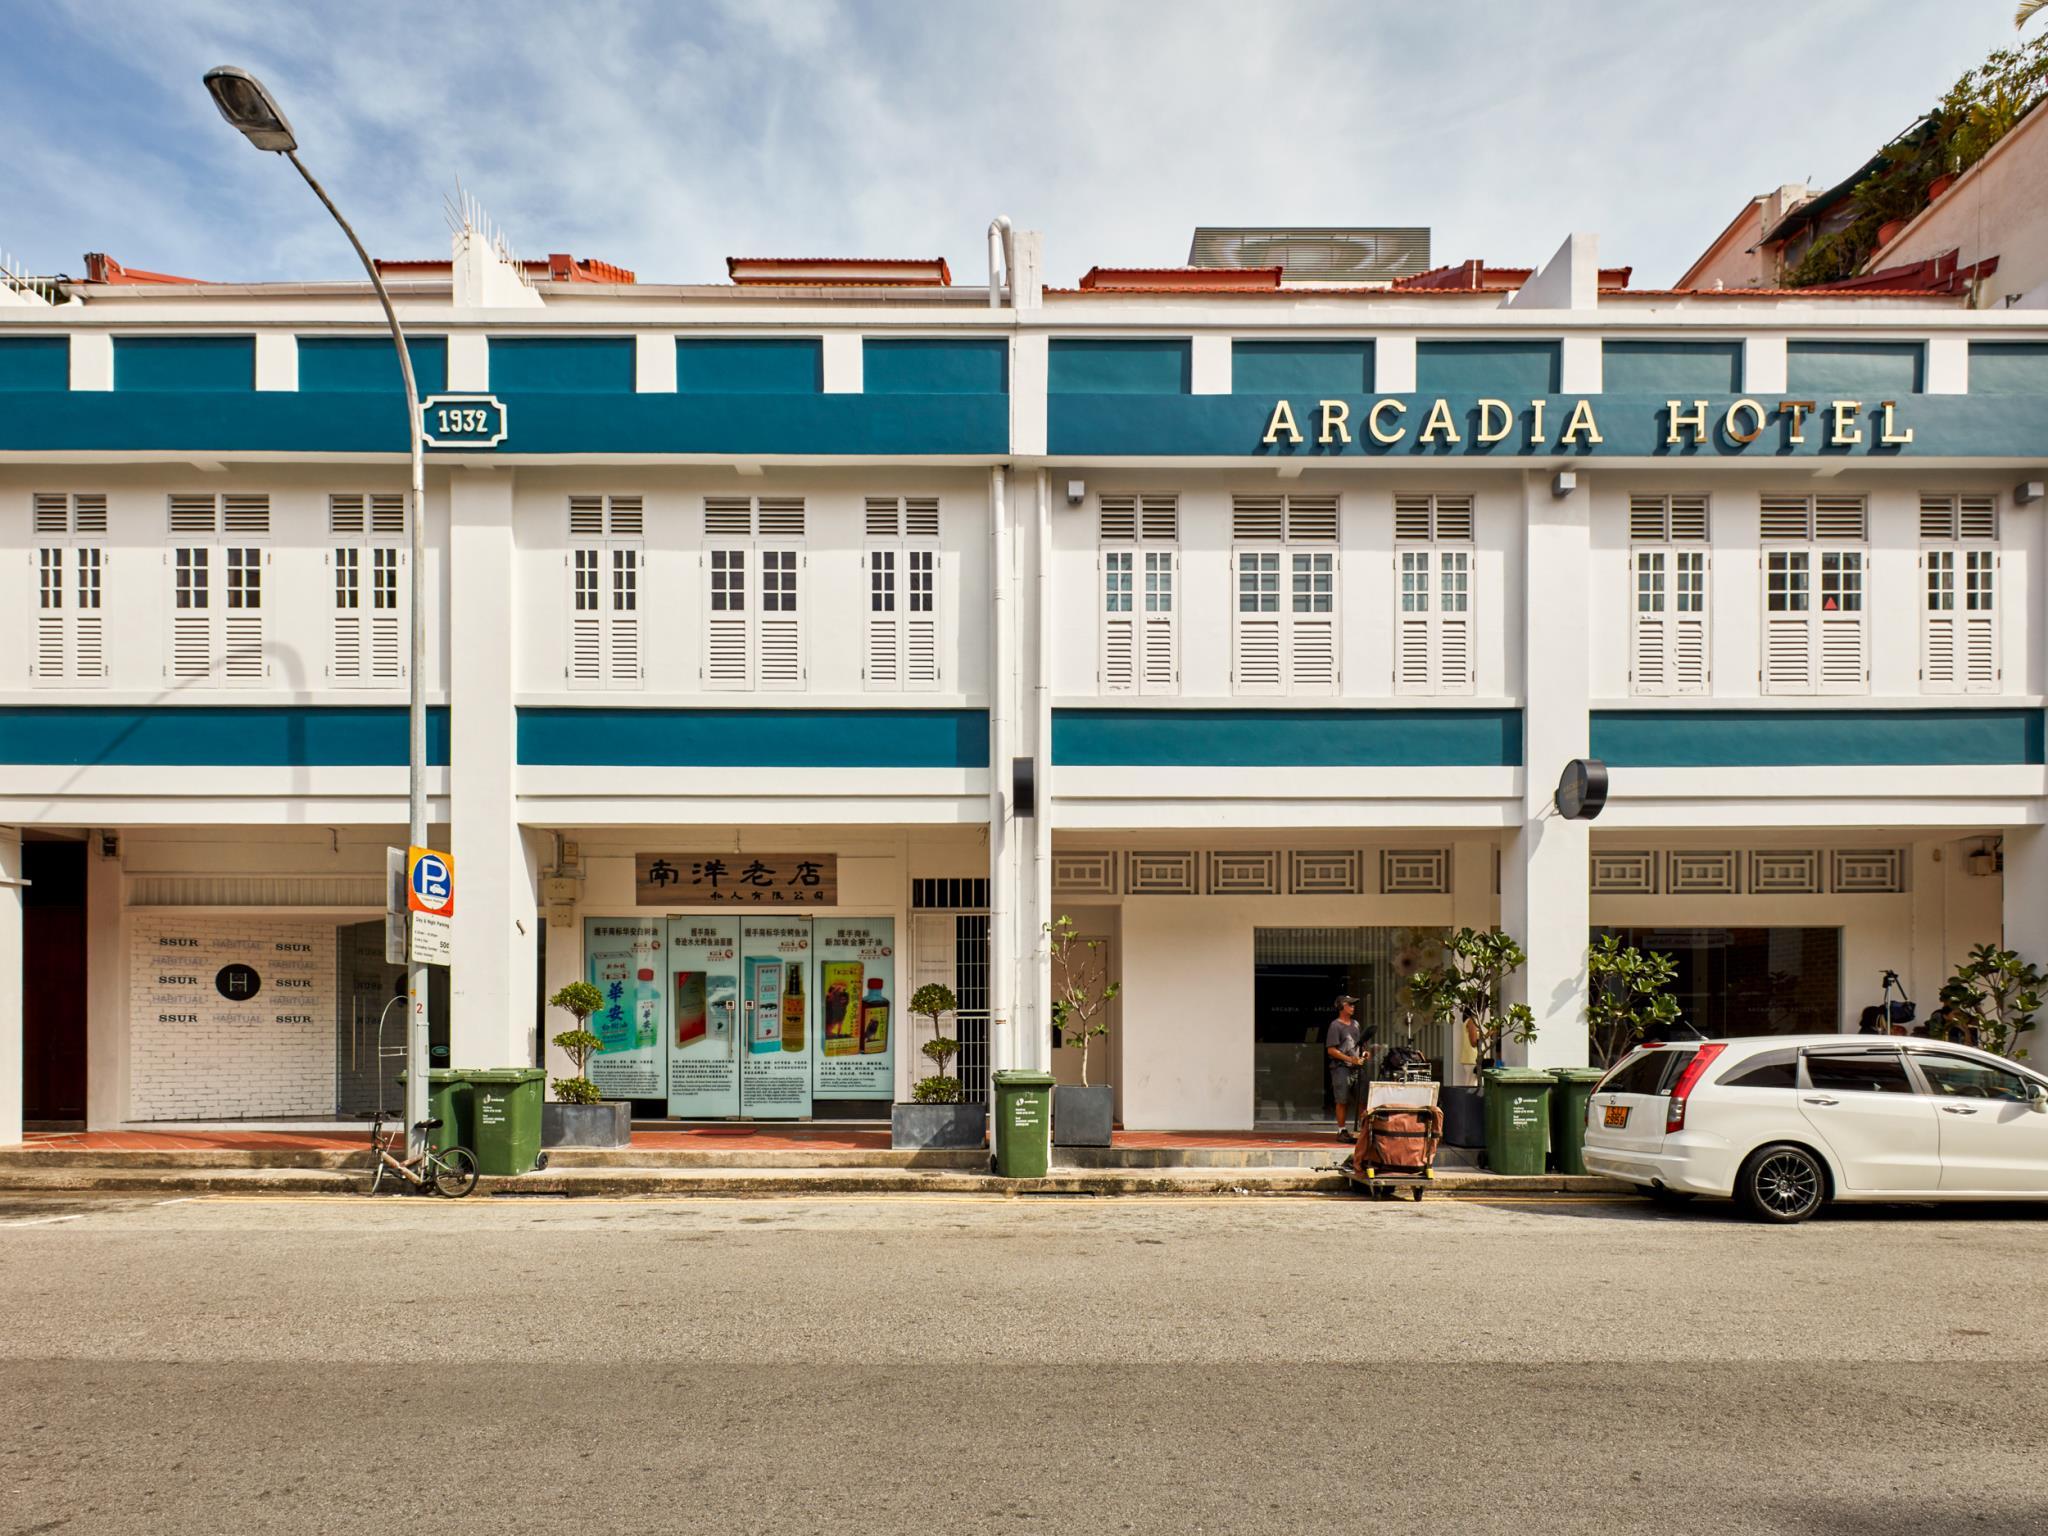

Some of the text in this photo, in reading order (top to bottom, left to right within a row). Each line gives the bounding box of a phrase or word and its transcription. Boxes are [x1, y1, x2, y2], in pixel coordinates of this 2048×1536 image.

[438, 409, 488, 432] 1932
[1262, 398, 1914, 444] ARCADIA HOTEL
[422, 858, 446, 894] P
[650, 858, 824, 888] 南洋老店
[710, 891, 824, 900] 私人有限公司
[160, 938, 199, 947] SSUR
[276, 944, 311, 952] SSUR
[158, 976, 198, 984] SSUR
[276, 979, 311, 987] SSUR
[417, 1003, 423, 1014] 2
[159, 1014, 198, 1022] SSUR
